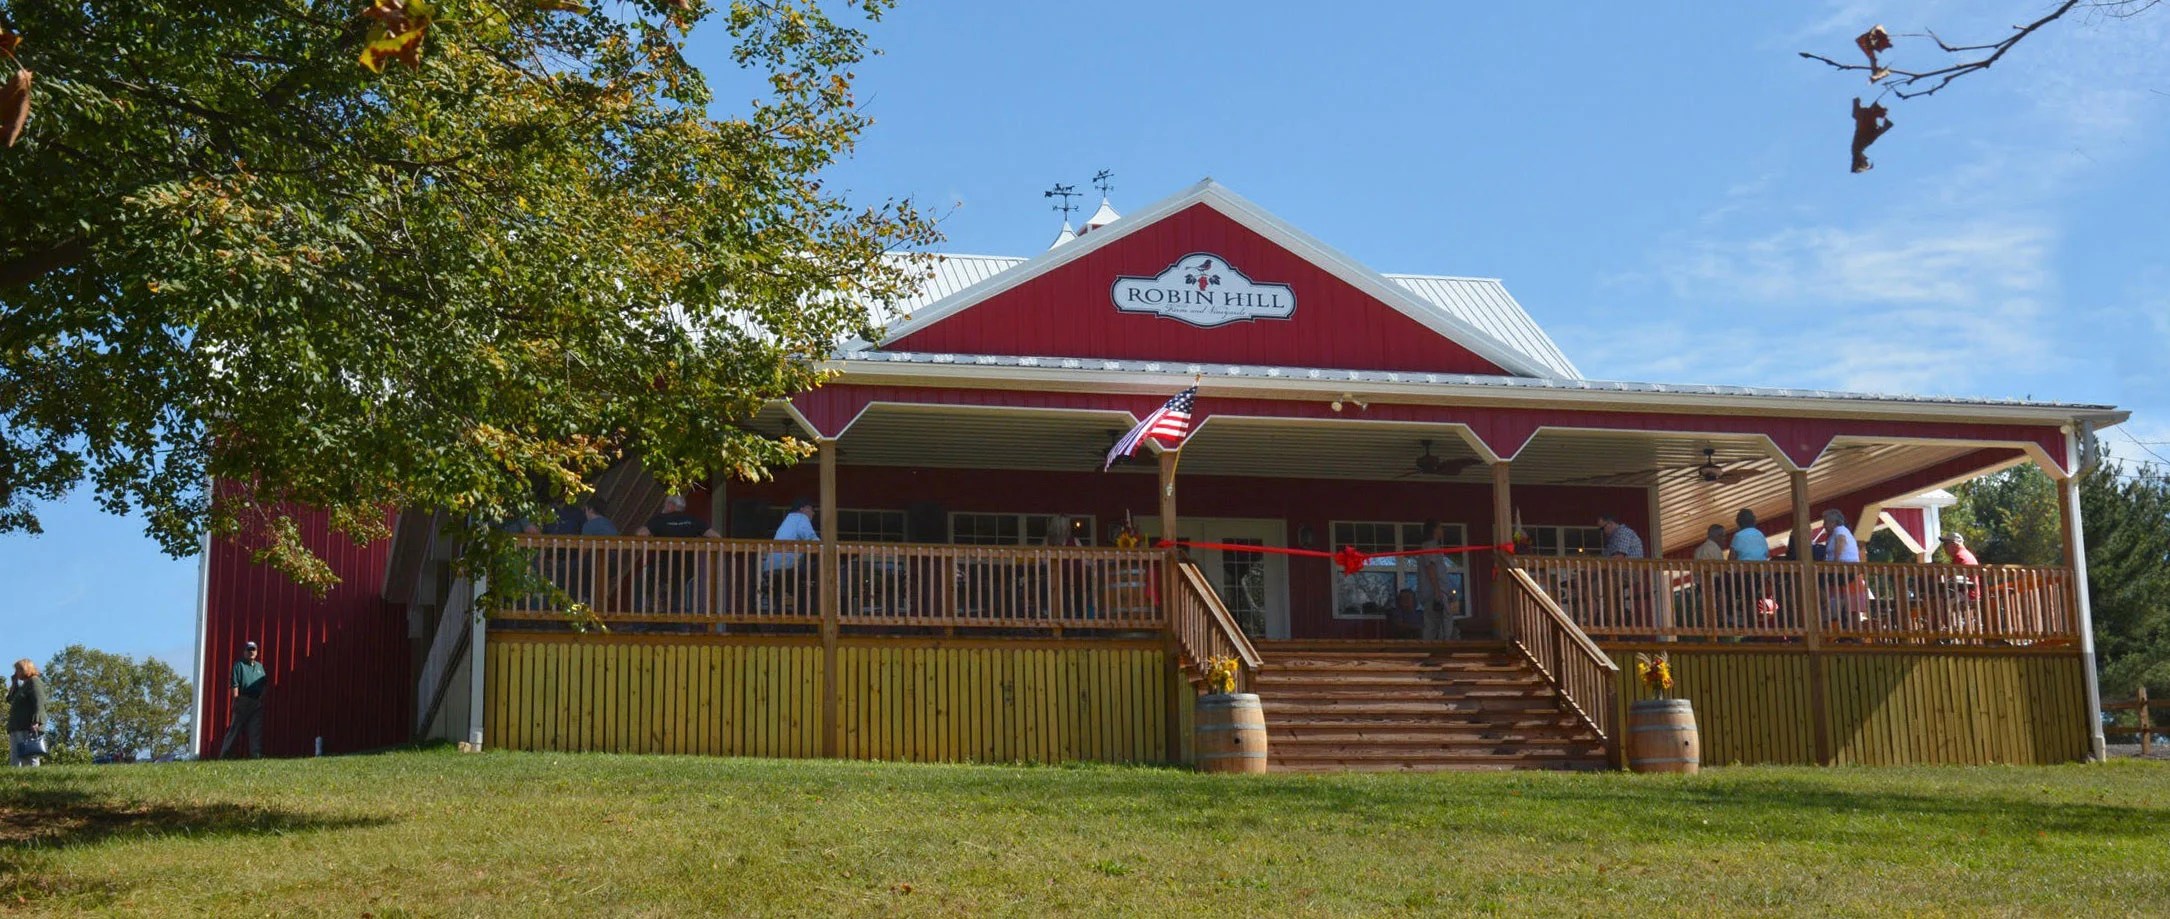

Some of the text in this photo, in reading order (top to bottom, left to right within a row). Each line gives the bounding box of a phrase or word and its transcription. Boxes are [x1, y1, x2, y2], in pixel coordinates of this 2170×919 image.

[1128, 288, 1285, 308] ROBIN HILL
[1190, 305, 1207, 314] and
